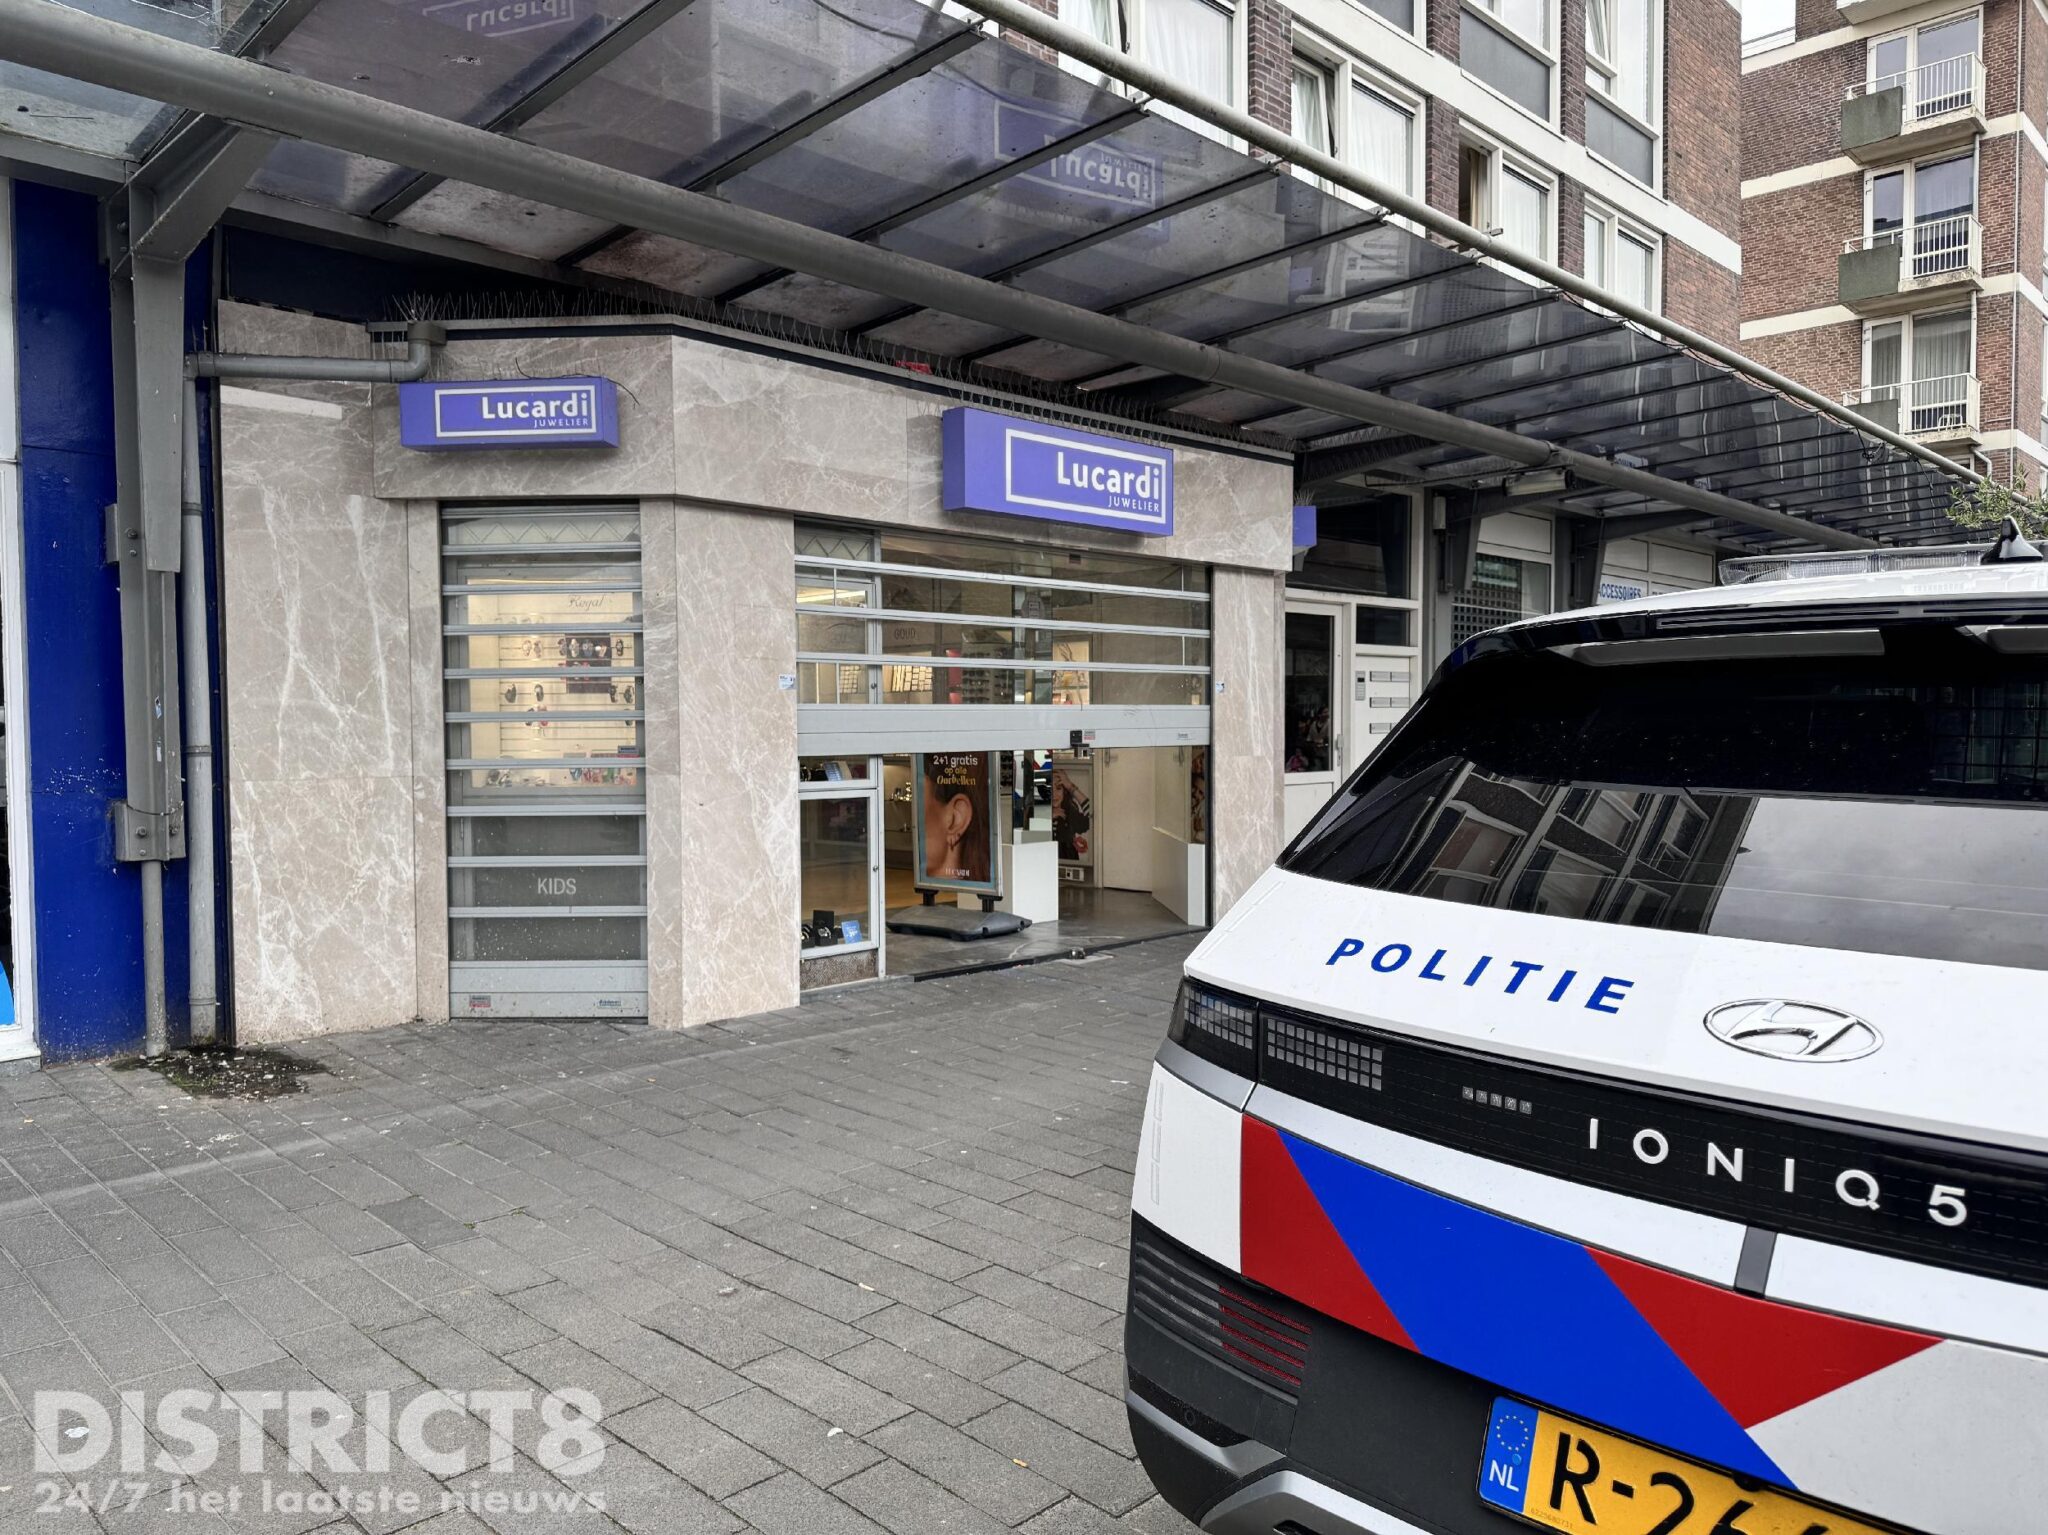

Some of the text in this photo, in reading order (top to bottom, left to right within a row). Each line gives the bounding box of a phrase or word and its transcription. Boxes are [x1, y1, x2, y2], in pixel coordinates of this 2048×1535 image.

[482, 392, 588, 418] Lucardi
[534, 418, 588, 428] JUWELIER
[1058, 452, 1159, 500] Lucardi
[1108, 496, 1159, 512] JUWELIER
[933, 754, 978, 768] 2+1 gratis
[944, 767, 953, 775] op
[537, 877, 577, 895] KIDS
[1326, 938, 1635, 1014] POLITIE
[1589, 1117, 1969, 1227] IONIQ 5
[1488, 1459, 1521, 1492] NL
